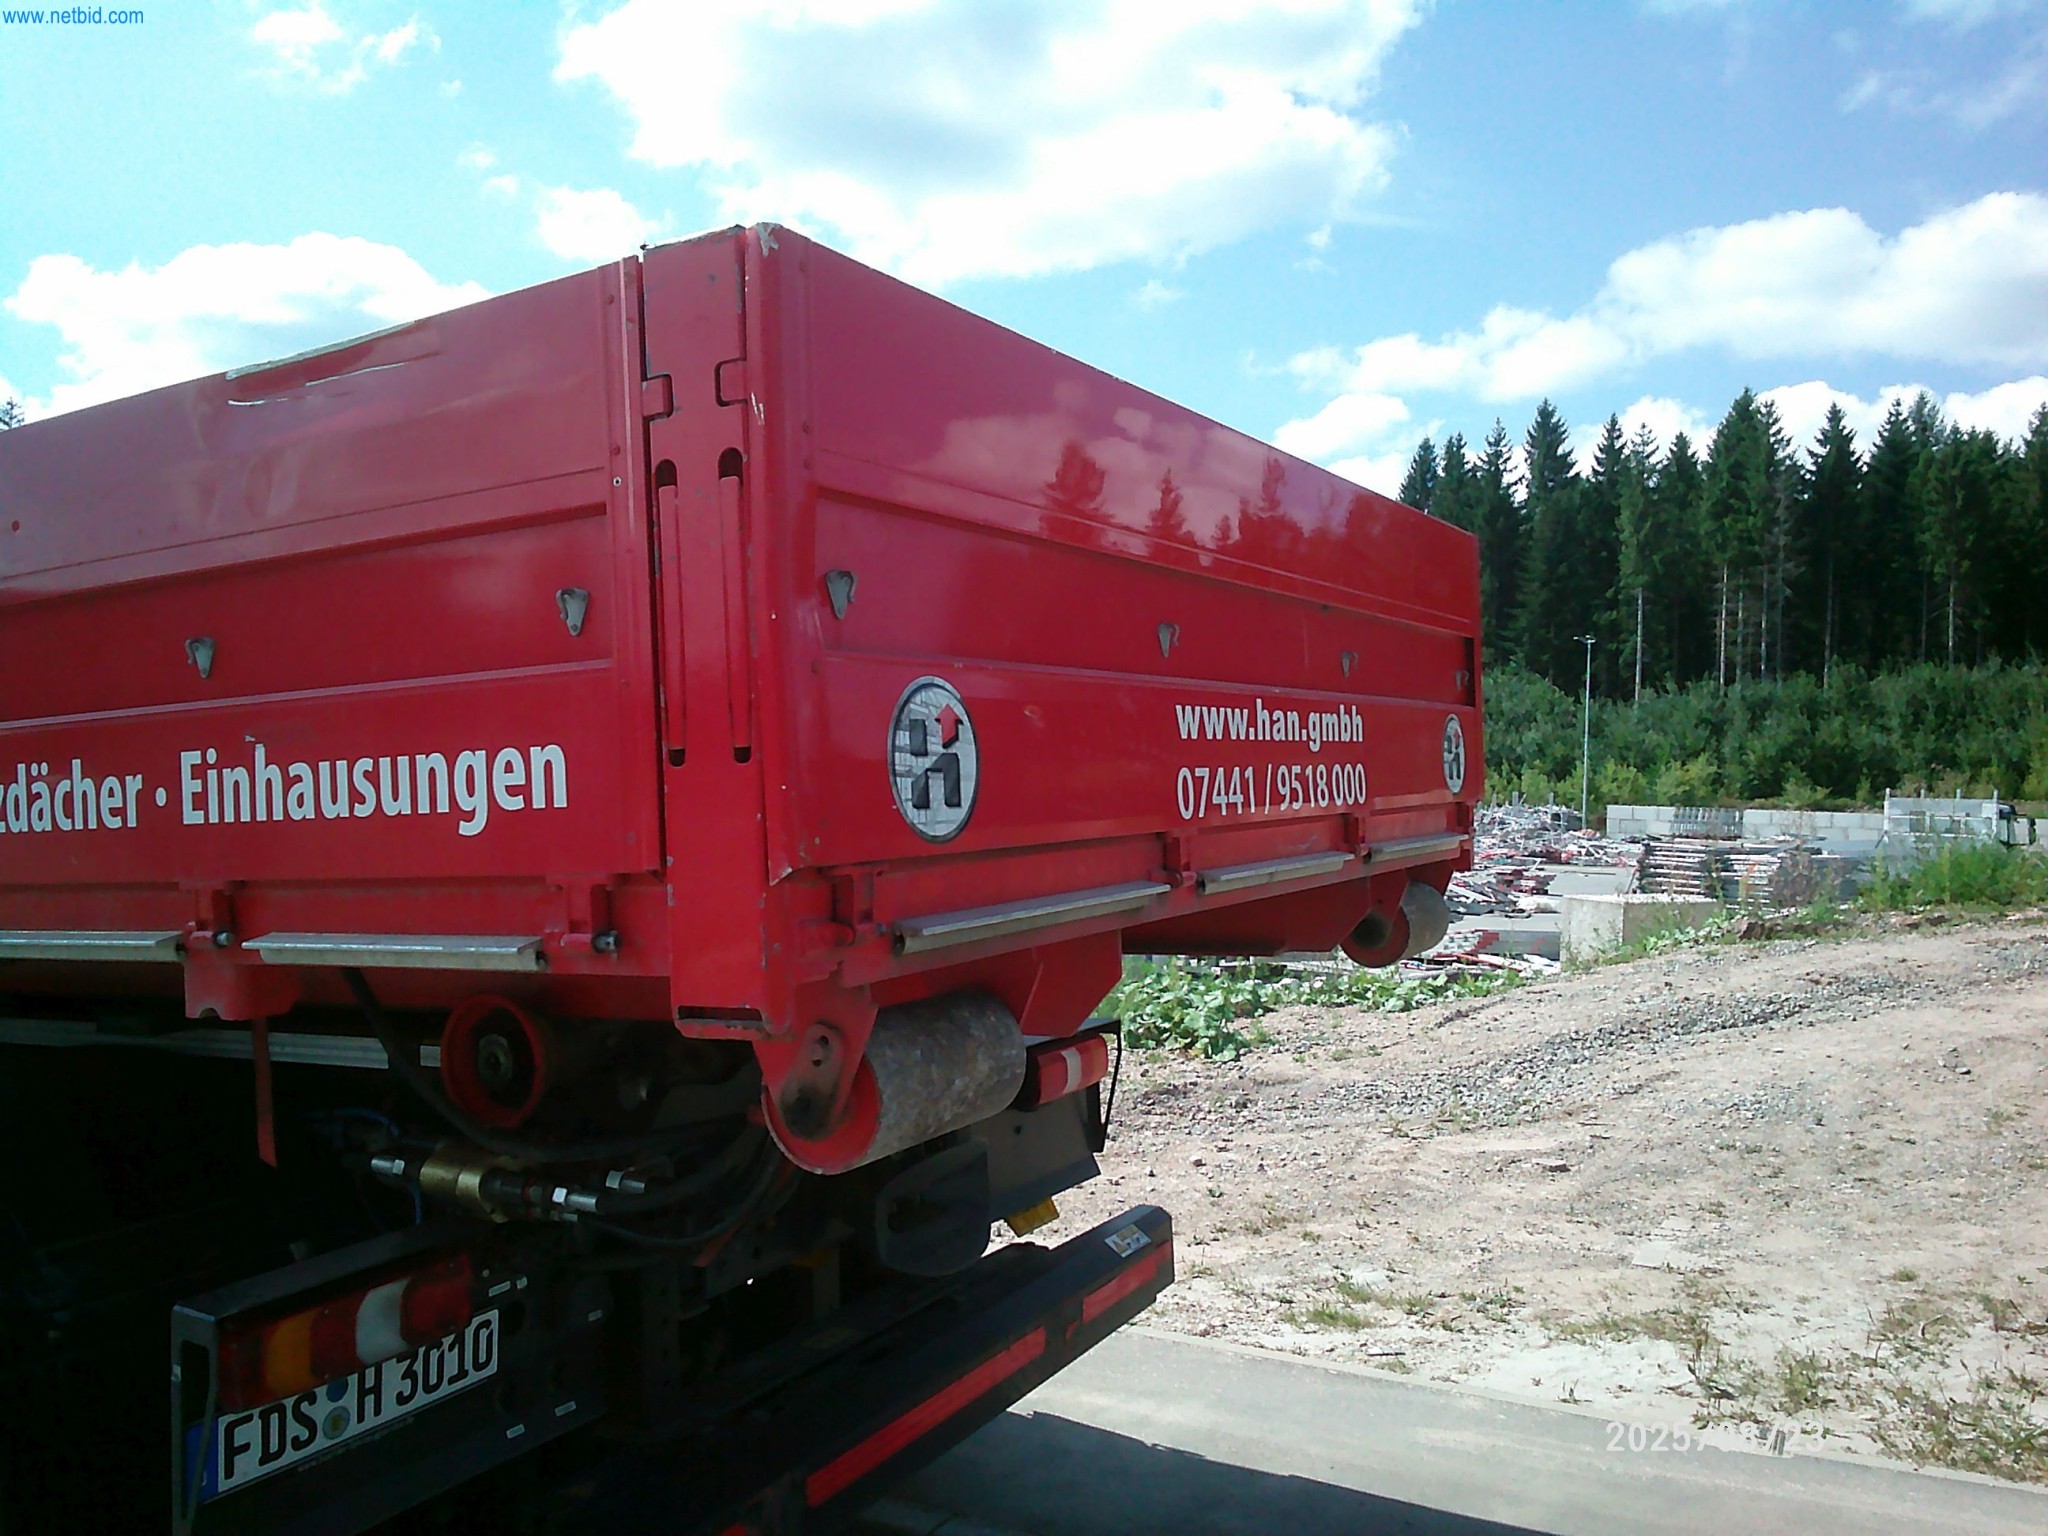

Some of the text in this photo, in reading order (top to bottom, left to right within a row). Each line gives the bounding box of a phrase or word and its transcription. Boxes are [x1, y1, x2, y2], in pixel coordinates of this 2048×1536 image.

[1175, 698, 1364, 752] www.han.gmbh
[180, 742, 568, 836] Einhausungen
[1177, 766, 1256, 820] 07441
[223, 1391, 318, 1480] FDS
[356, 1363, 383, 1424] H
[395, 1319, 492, 1406] 3010
